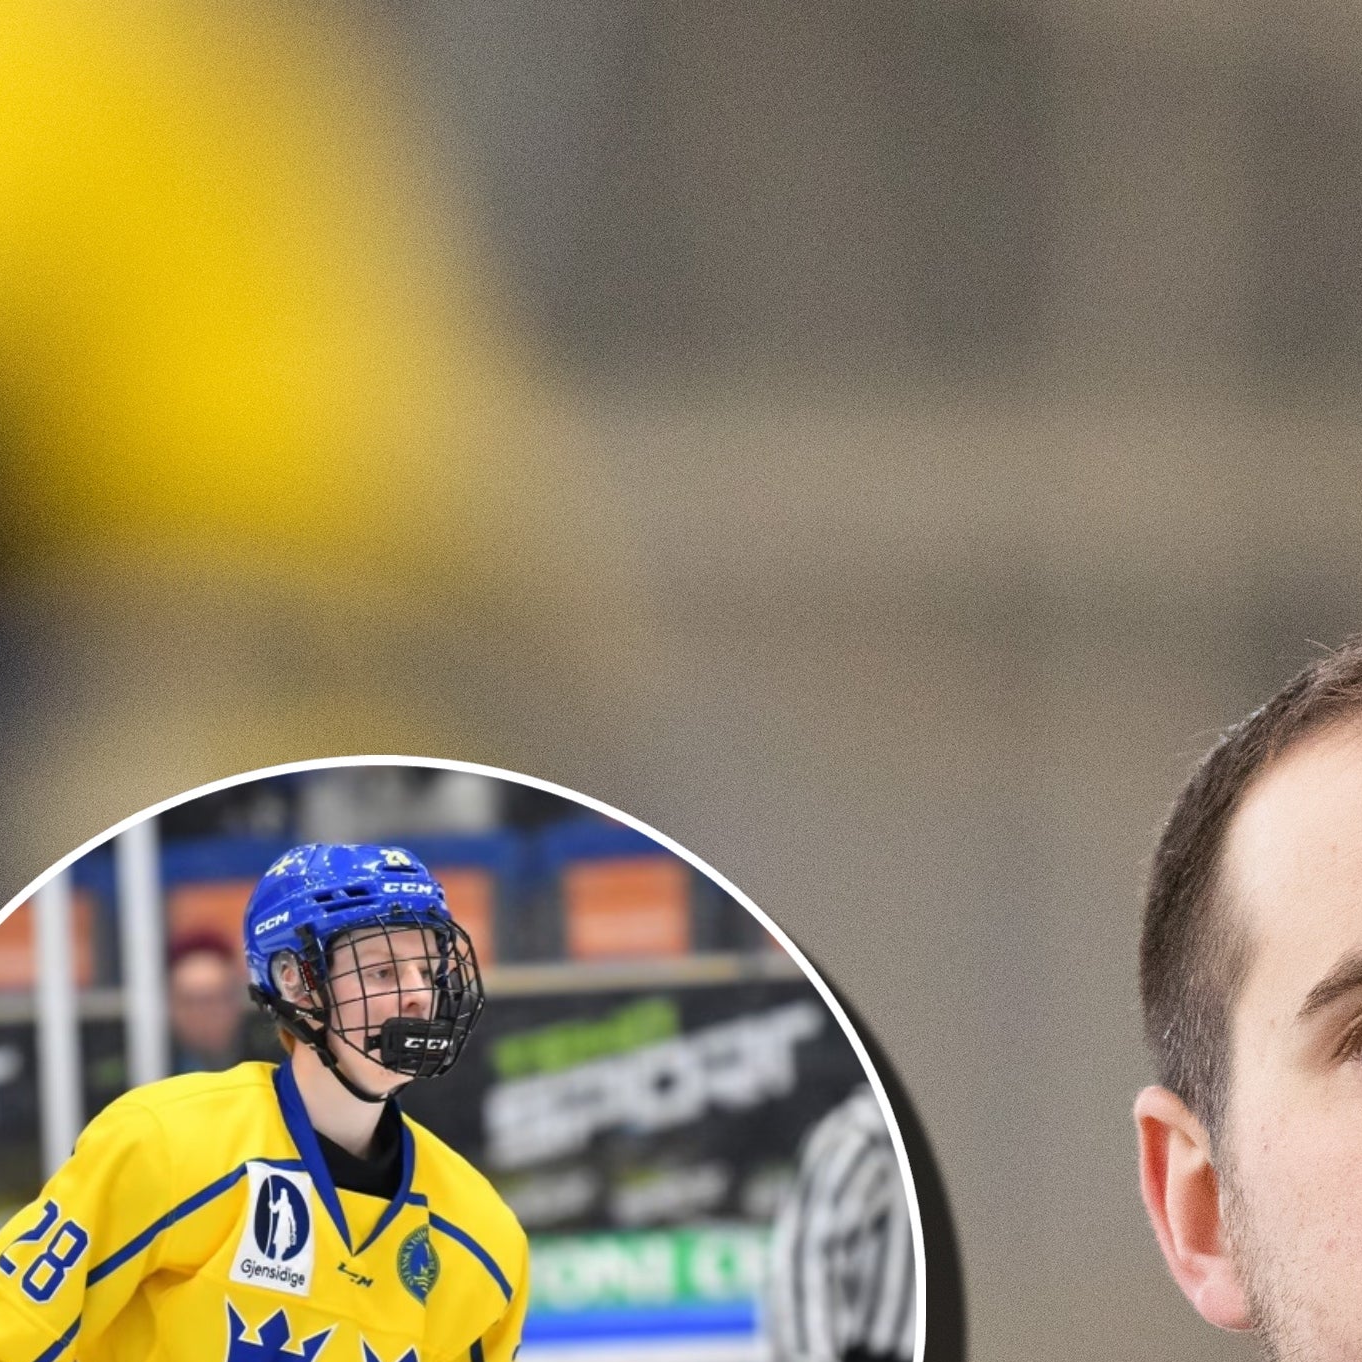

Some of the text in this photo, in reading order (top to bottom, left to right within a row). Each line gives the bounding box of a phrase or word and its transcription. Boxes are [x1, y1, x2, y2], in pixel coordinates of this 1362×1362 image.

[382, 881, 433, 895] CCM
[254, 911, 290, 936] CCM
[240, 1257, 306, 1289] Gjensidige
